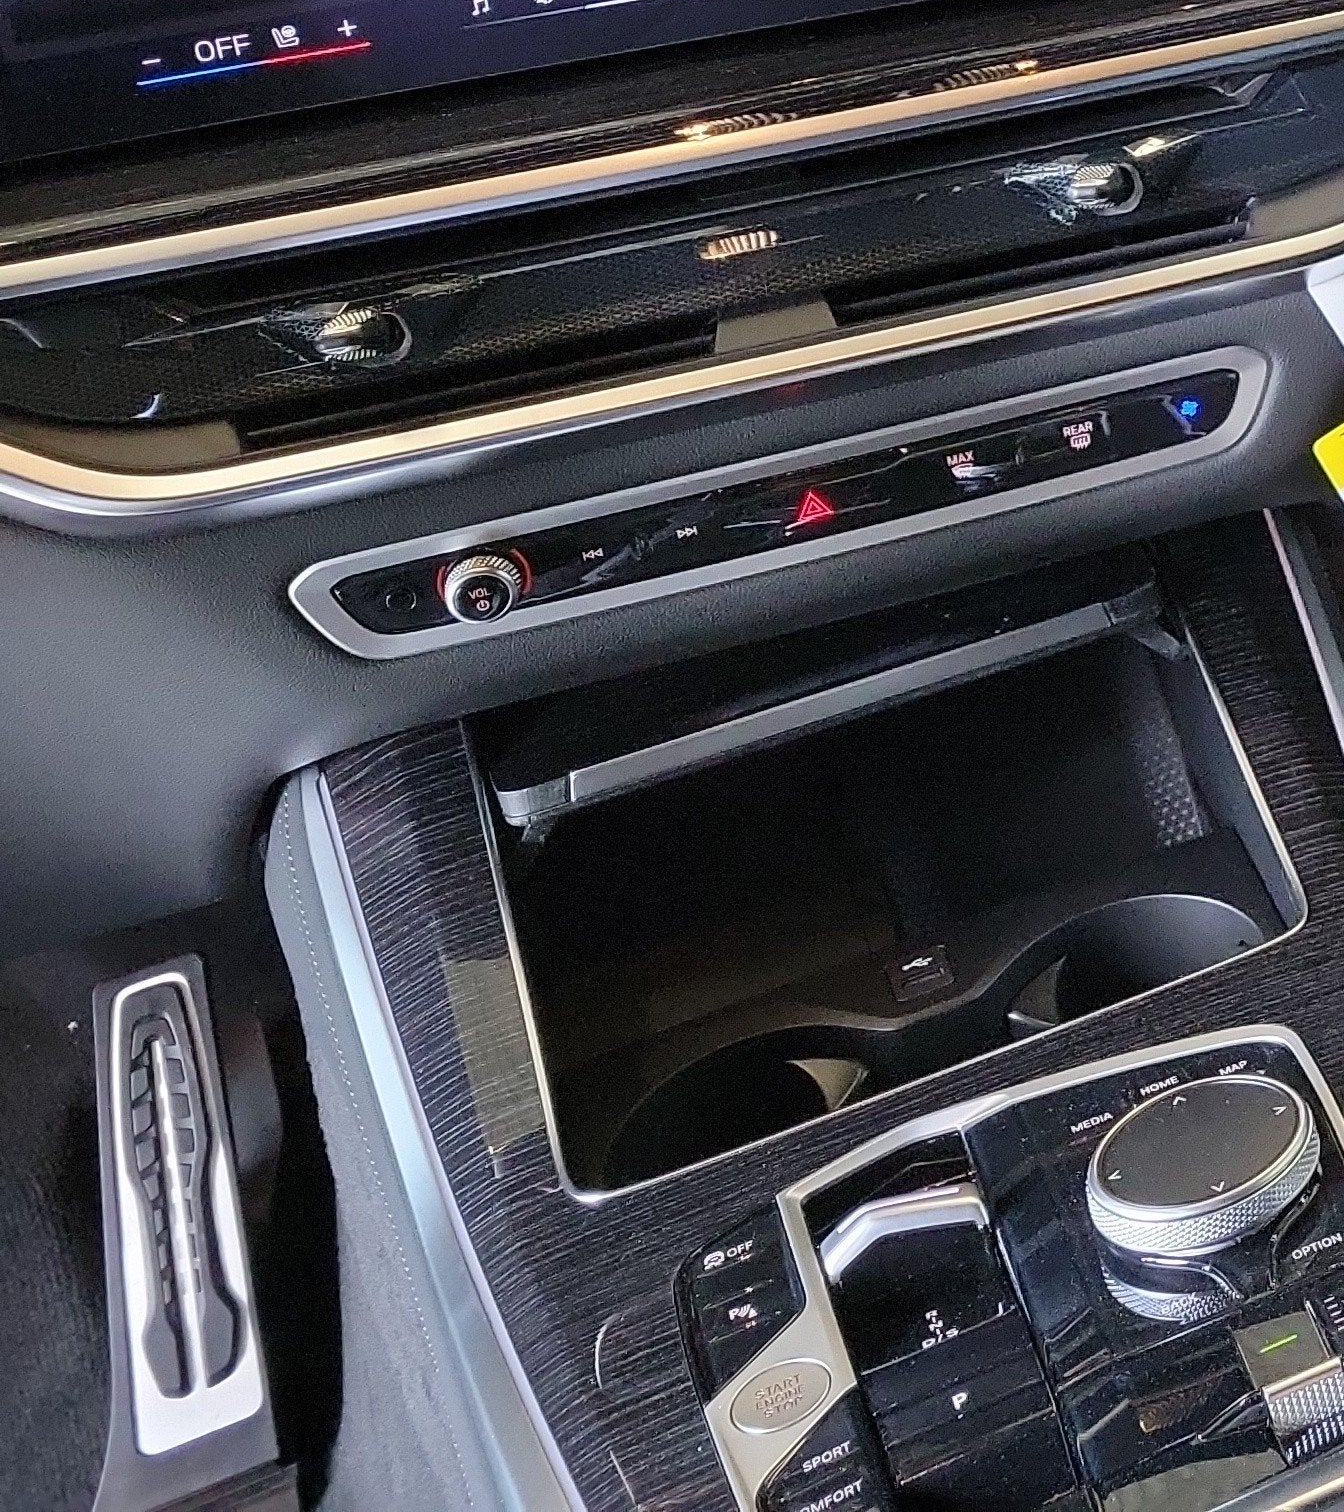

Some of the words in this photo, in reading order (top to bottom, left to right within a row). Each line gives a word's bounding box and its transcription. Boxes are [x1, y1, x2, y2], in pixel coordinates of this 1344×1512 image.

[194, 33, 251, 62] OFF
[1062, 420, 1093, 438] REAR
[946, 450, 975, 467] MAX
[468, 587, 491, 599] VOL
[1217, 1060, 1248, 1076] MAP
[1139, 1076, 1179, 1096] HOME
[1070, 1112, 1114, 1134] MEDIA
[727, 1240, 753, 1257] OFF
[1291, 1231, 1343, 1261] OPTION
[755, 1373, 800, 1399] START
[755, 1384, 805, 1411] ENGINE
[763, 1396, 803, 1418] STOP
[951, 1392, 968, 1410] P
[802, 1441, 850, 1473] SPORT
[797, 1476, 864, 1512] OMFORT
